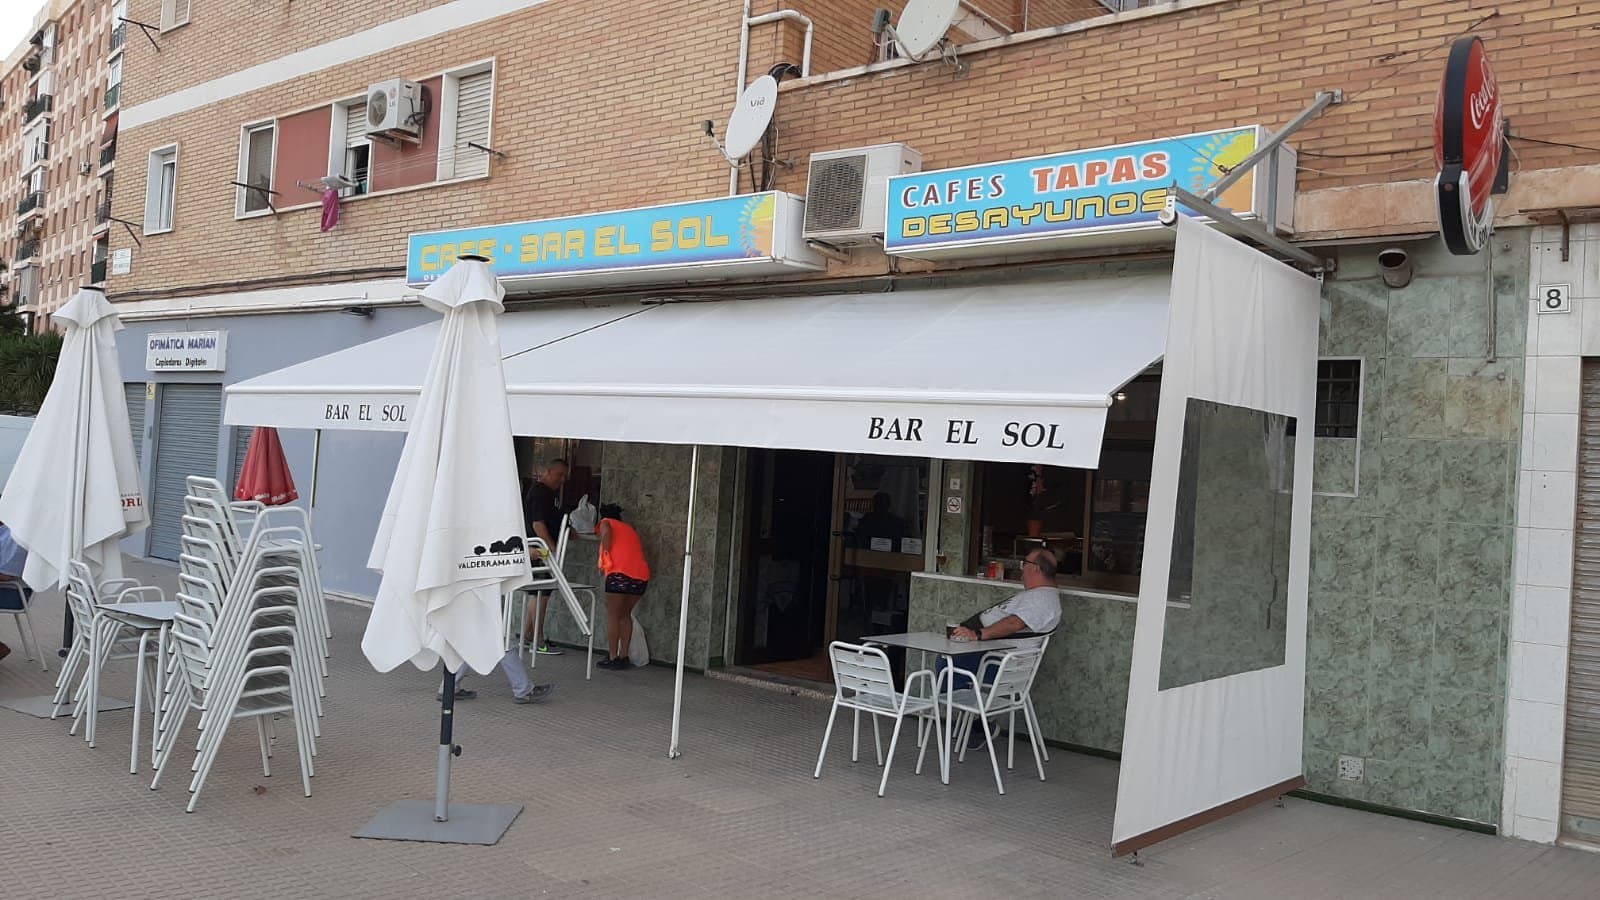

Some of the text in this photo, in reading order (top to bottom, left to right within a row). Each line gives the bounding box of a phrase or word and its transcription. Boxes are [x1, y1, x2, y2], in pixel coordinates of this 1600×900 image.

[903, 153, 1168, 208] CAFES TAPAS
[902, 187, 1168, 238] DESAYUNOS
[519, 230, 585, 263] BAR
[594, 225, 640, 257] EL
[651, 216, 729, 252] SOL
[1546, 289, 1561, 309] 8
[188, 337, 216, 349] MARIAN
[325, 404, 406, 422] BAR EL SOL
[868, 417, 1065, 450] BAR EL SOL
[458, 559, 511, 569] VALDERRAMA
